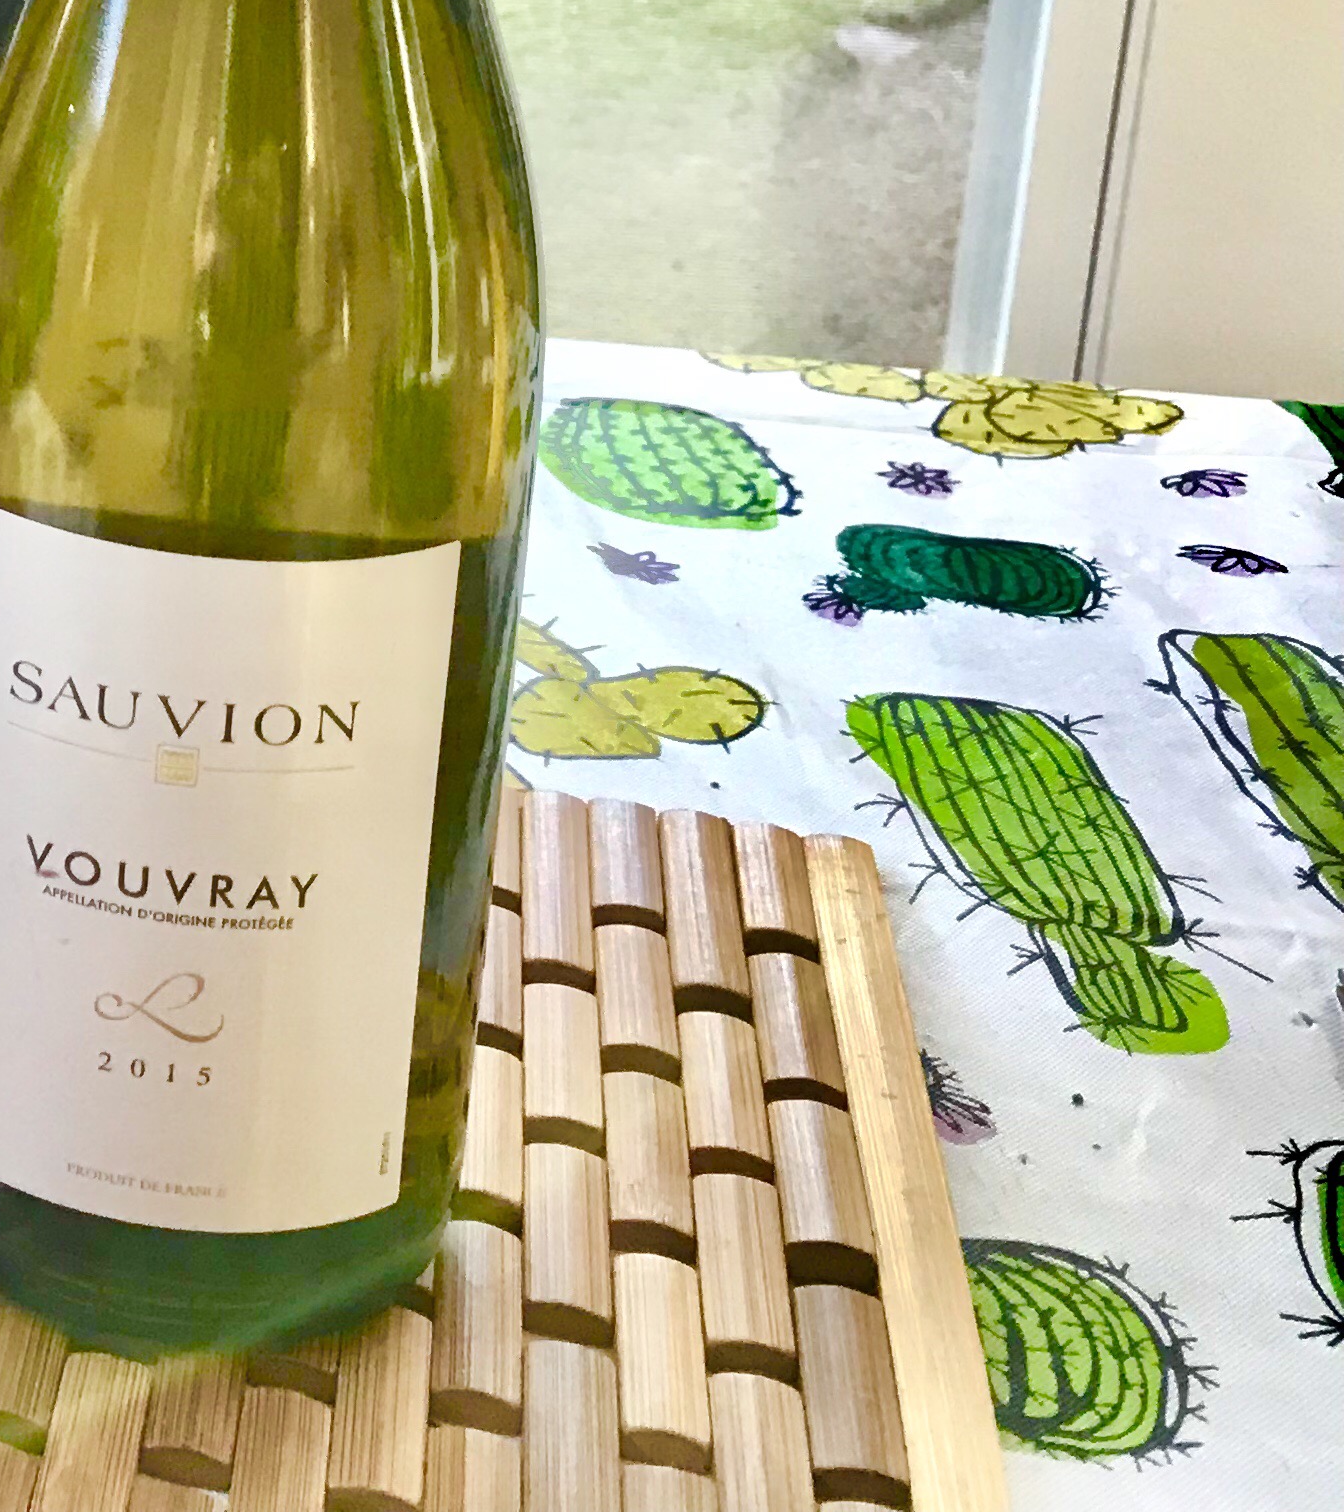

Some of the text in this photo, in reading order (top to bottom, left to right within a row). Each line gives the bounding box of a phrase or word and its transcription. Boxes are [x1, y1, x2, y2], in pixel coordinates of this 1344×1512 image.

[9, 659, 361, 747] SAUVION
[25, 834, 320, 912] VOUVRAY
[42, 884, 133, 918] APPELLATION
[137, 907, 216, 930] D'ORIGINE
[98, 1051, 211, 1087] 2015
[139, 1178, 162, 1193] DE
